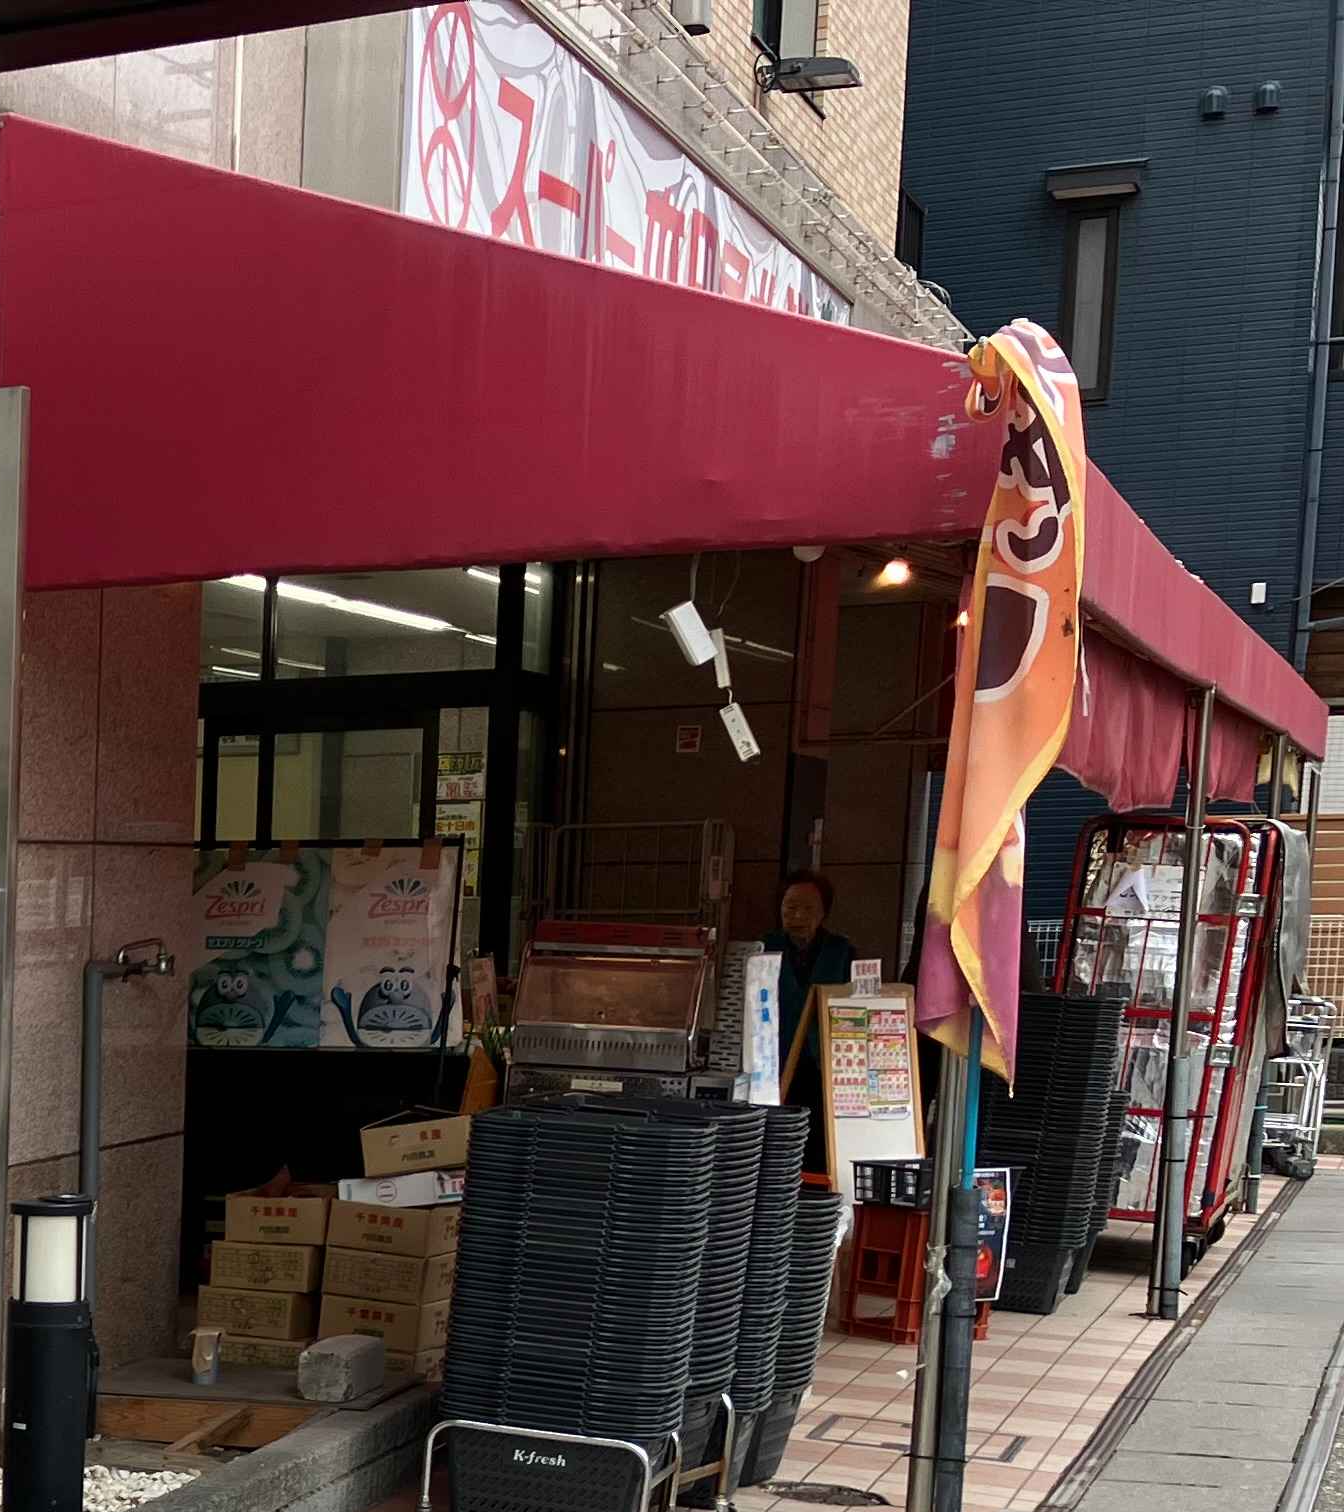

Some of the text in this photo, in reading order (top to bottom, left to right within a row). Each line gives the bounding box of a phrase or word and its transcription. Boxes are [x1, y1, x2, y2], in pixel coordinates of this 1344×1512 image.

[205, 895, 267, 920] Zespri
[367, 893, 432, 919] Zespri
[513, 1449, 566, 1467] K-fresh
